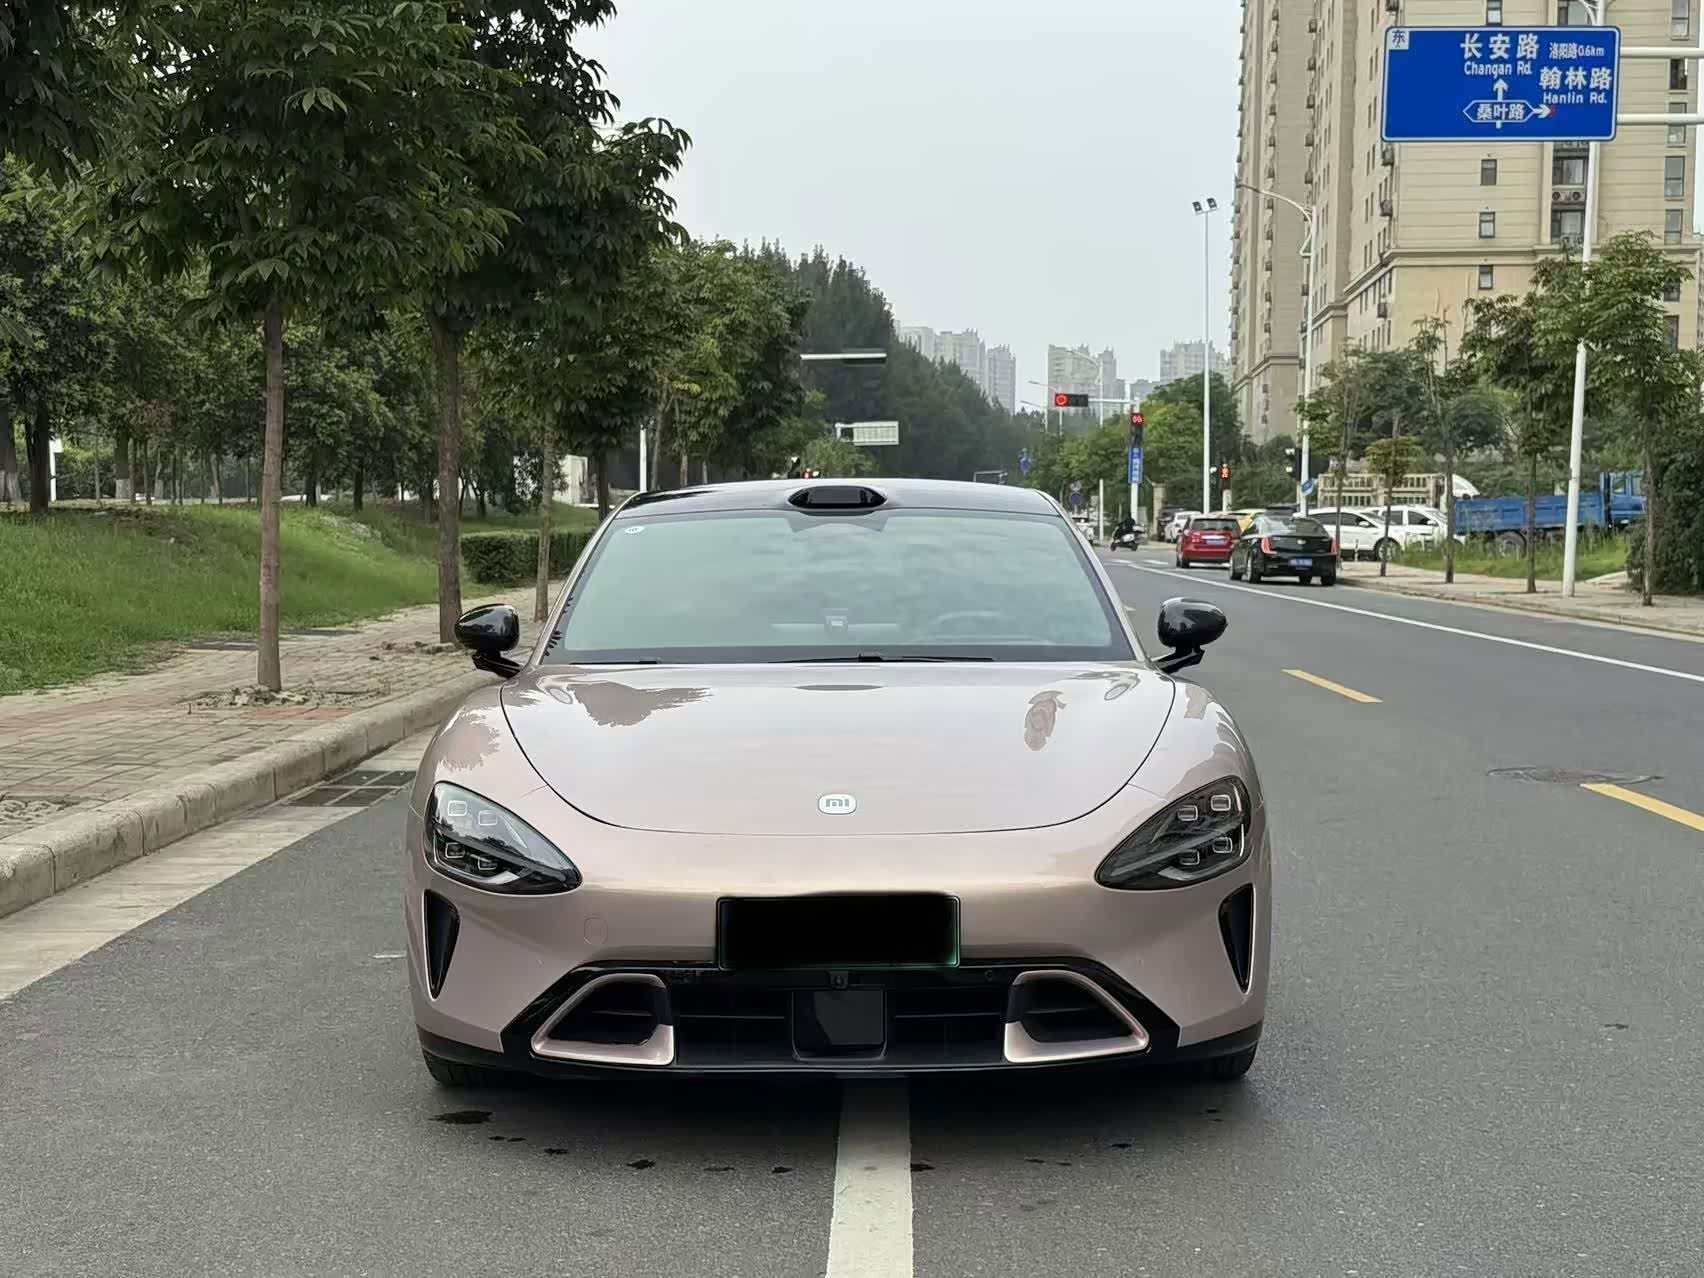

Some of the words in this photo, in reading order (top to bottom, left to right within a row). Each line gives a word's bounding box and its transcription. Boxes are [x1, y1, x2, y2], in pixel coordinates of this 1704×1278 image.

[1460, 33, 1540, 60] 长安路
[1464, 62, 1512, 79] Changan
[1539, 67, 1612, 90] 翰林路
[1543, 92, 1583, 104] Hanlin
[1590, 92, 1608, 104] Rd.
[1477, 104, 1525, 120] 桑叶路
